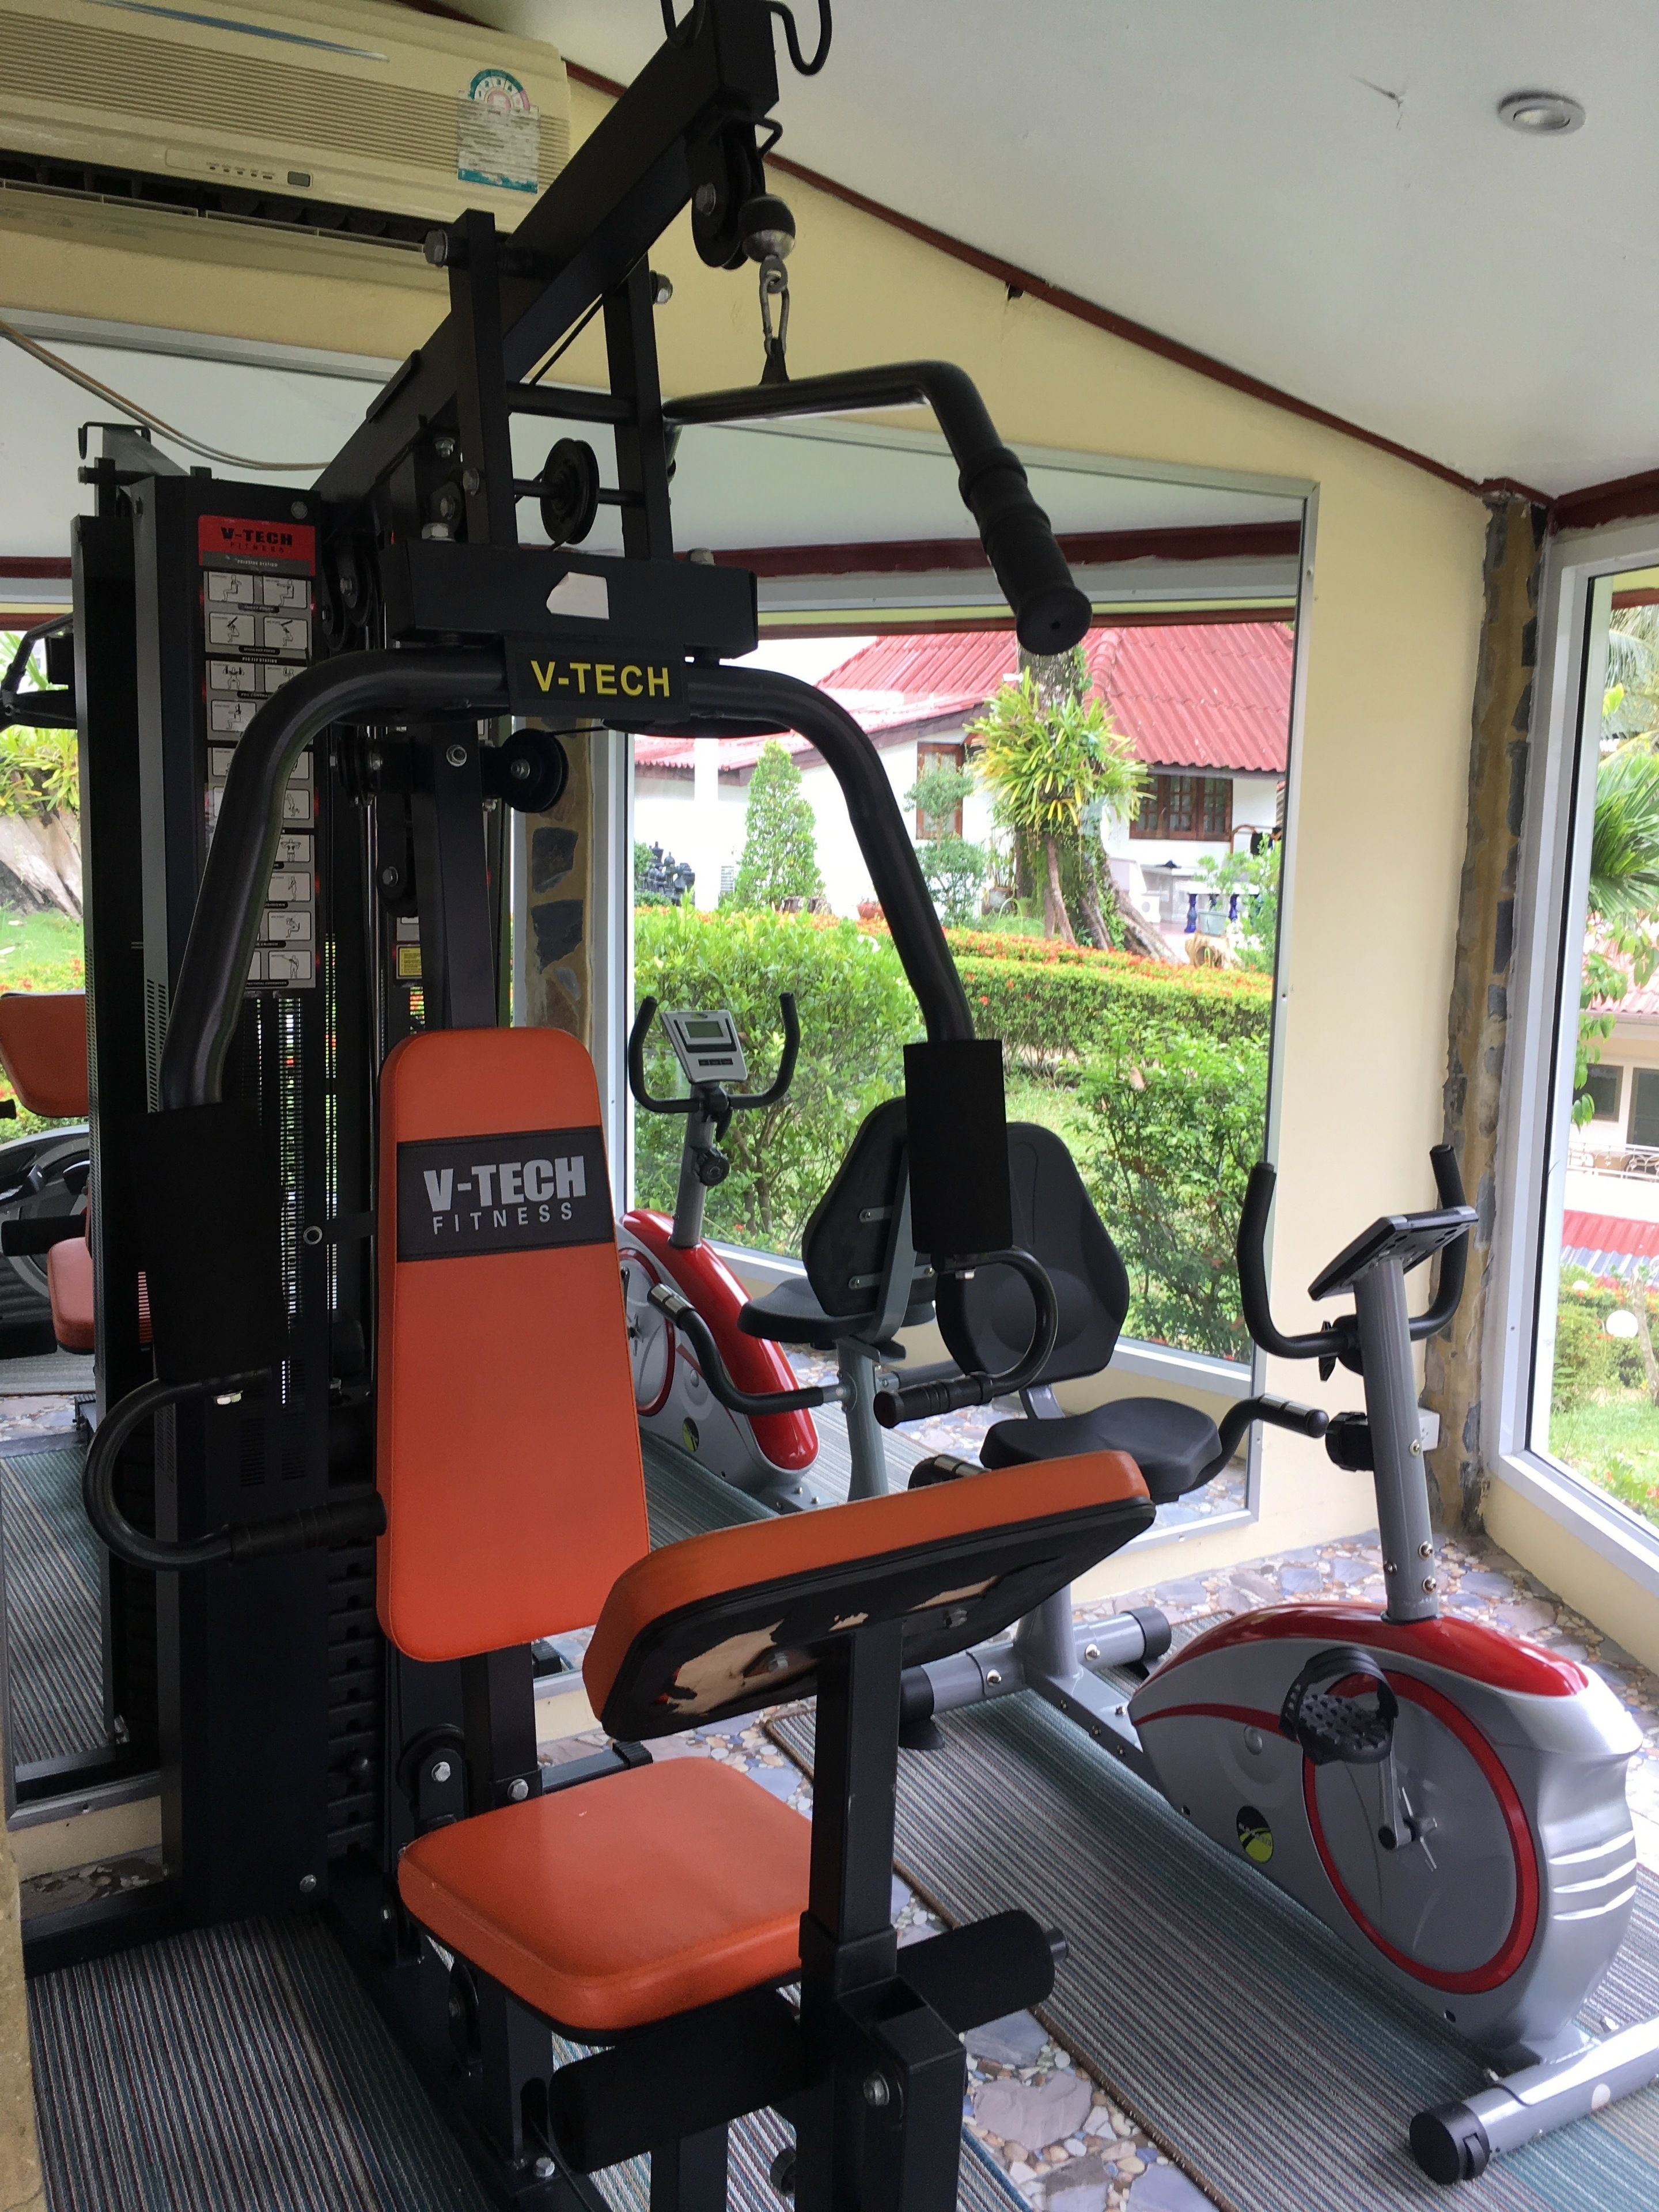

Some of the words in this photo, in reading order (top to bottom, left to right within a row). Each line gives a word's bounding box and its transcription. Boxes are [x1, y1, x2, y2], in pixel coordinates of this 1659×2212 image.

[221, 527, 293, 546] V-TECH
[230, 542, 285, 554] FITNESS
[531, 660, 670, 697] V-TECH
[423, 1155, 587, 1212] V-TECH
[433, 1202, 572, 1234] FITNESS
